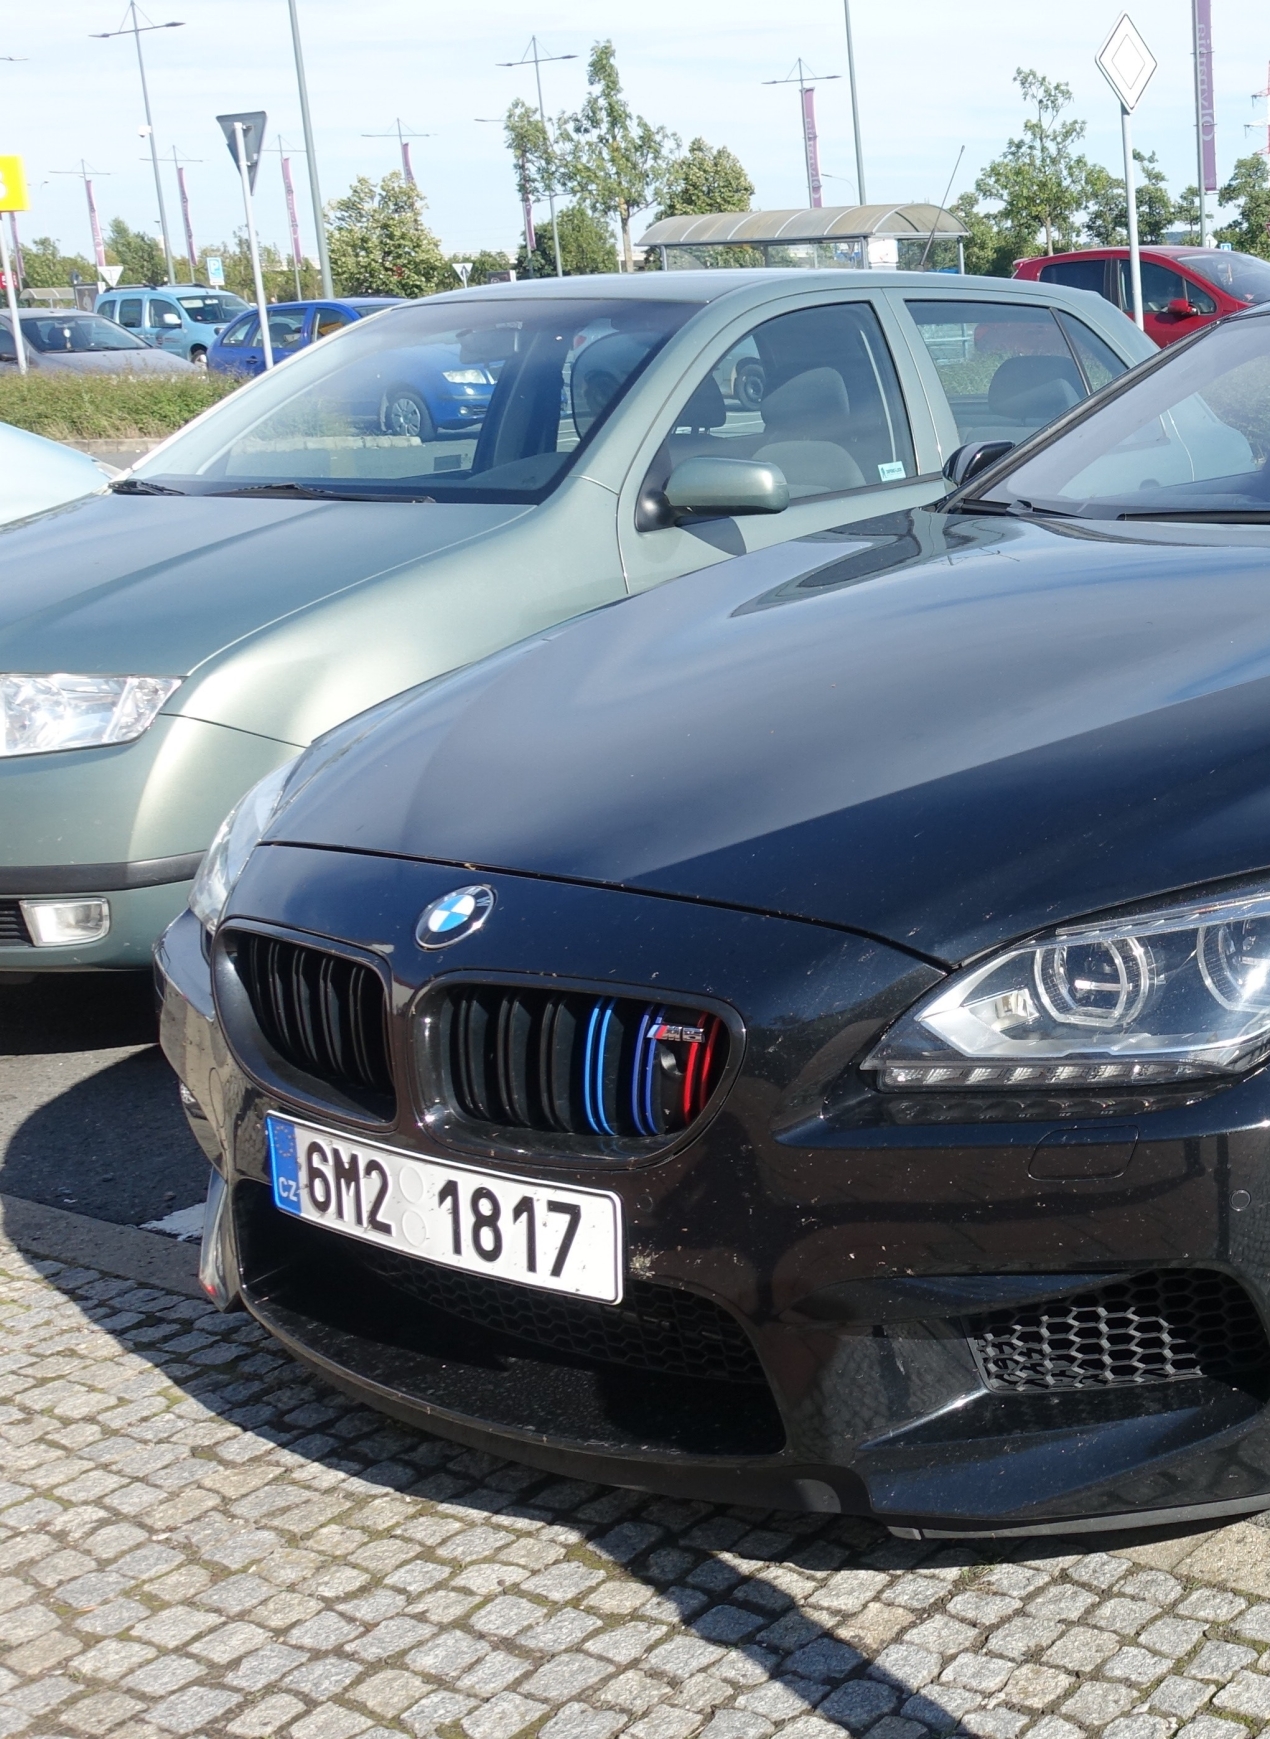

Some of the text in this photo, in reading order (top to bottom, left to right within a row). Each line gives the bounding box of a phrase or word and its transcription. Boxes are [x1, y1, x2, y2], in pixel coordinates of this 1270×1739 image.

[278, 1177, 299, 1203] CZ
[306, 1140, 583, 1279] 6M2 1817
